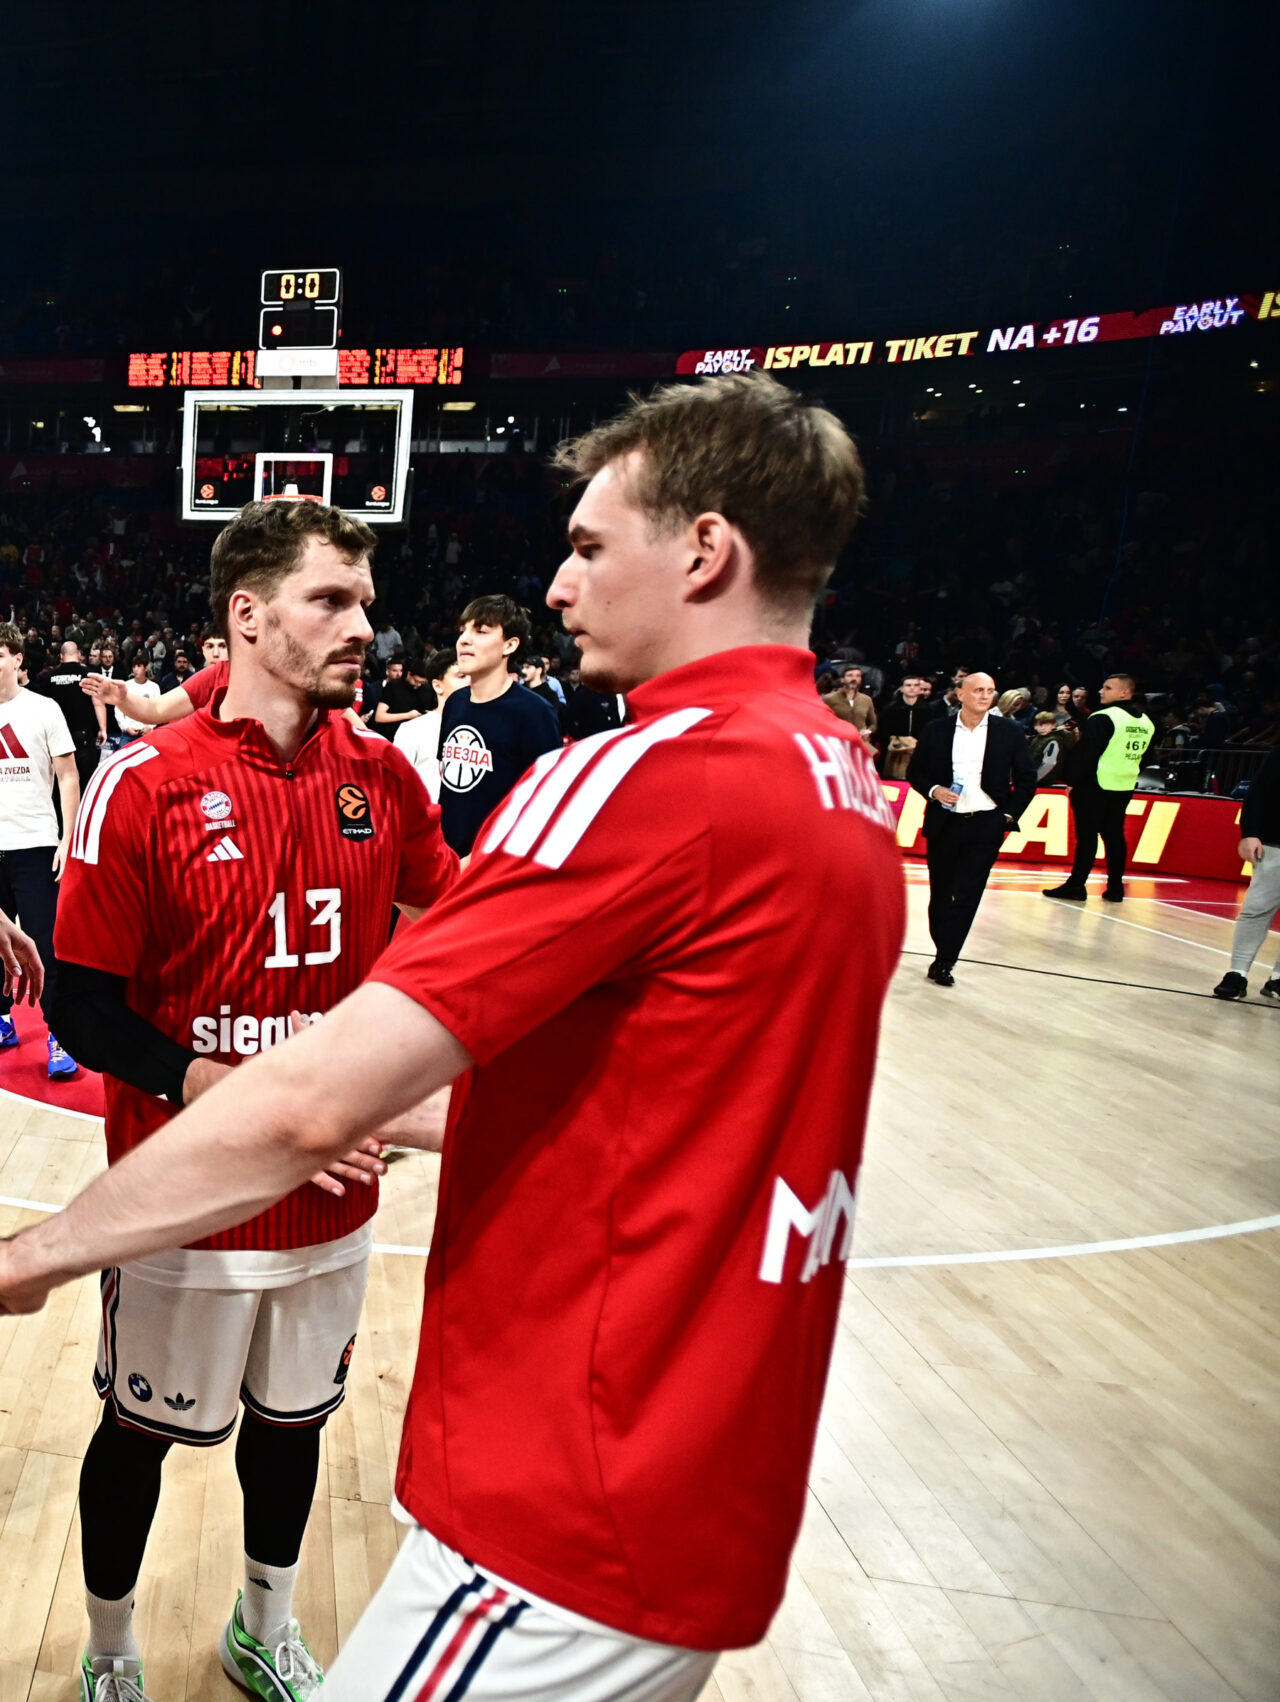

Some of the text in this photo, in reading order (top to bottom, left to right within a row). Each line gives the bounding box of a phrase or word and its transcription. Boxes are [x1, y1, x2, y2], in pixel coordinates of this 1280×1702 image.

[1173, 298, 1239, 322] EARLY
[1159, 309, 1245, 336] PAYOUT
[763, 316, 1101, 370] ISPLATI TIKET NA +16
[694, 358, 755, 375] PAYOUT
[703, 348, 751, 365] EARLY
[4, 766, 31, 775] ZVEZDA
[264, 888, 341, 968] 13
